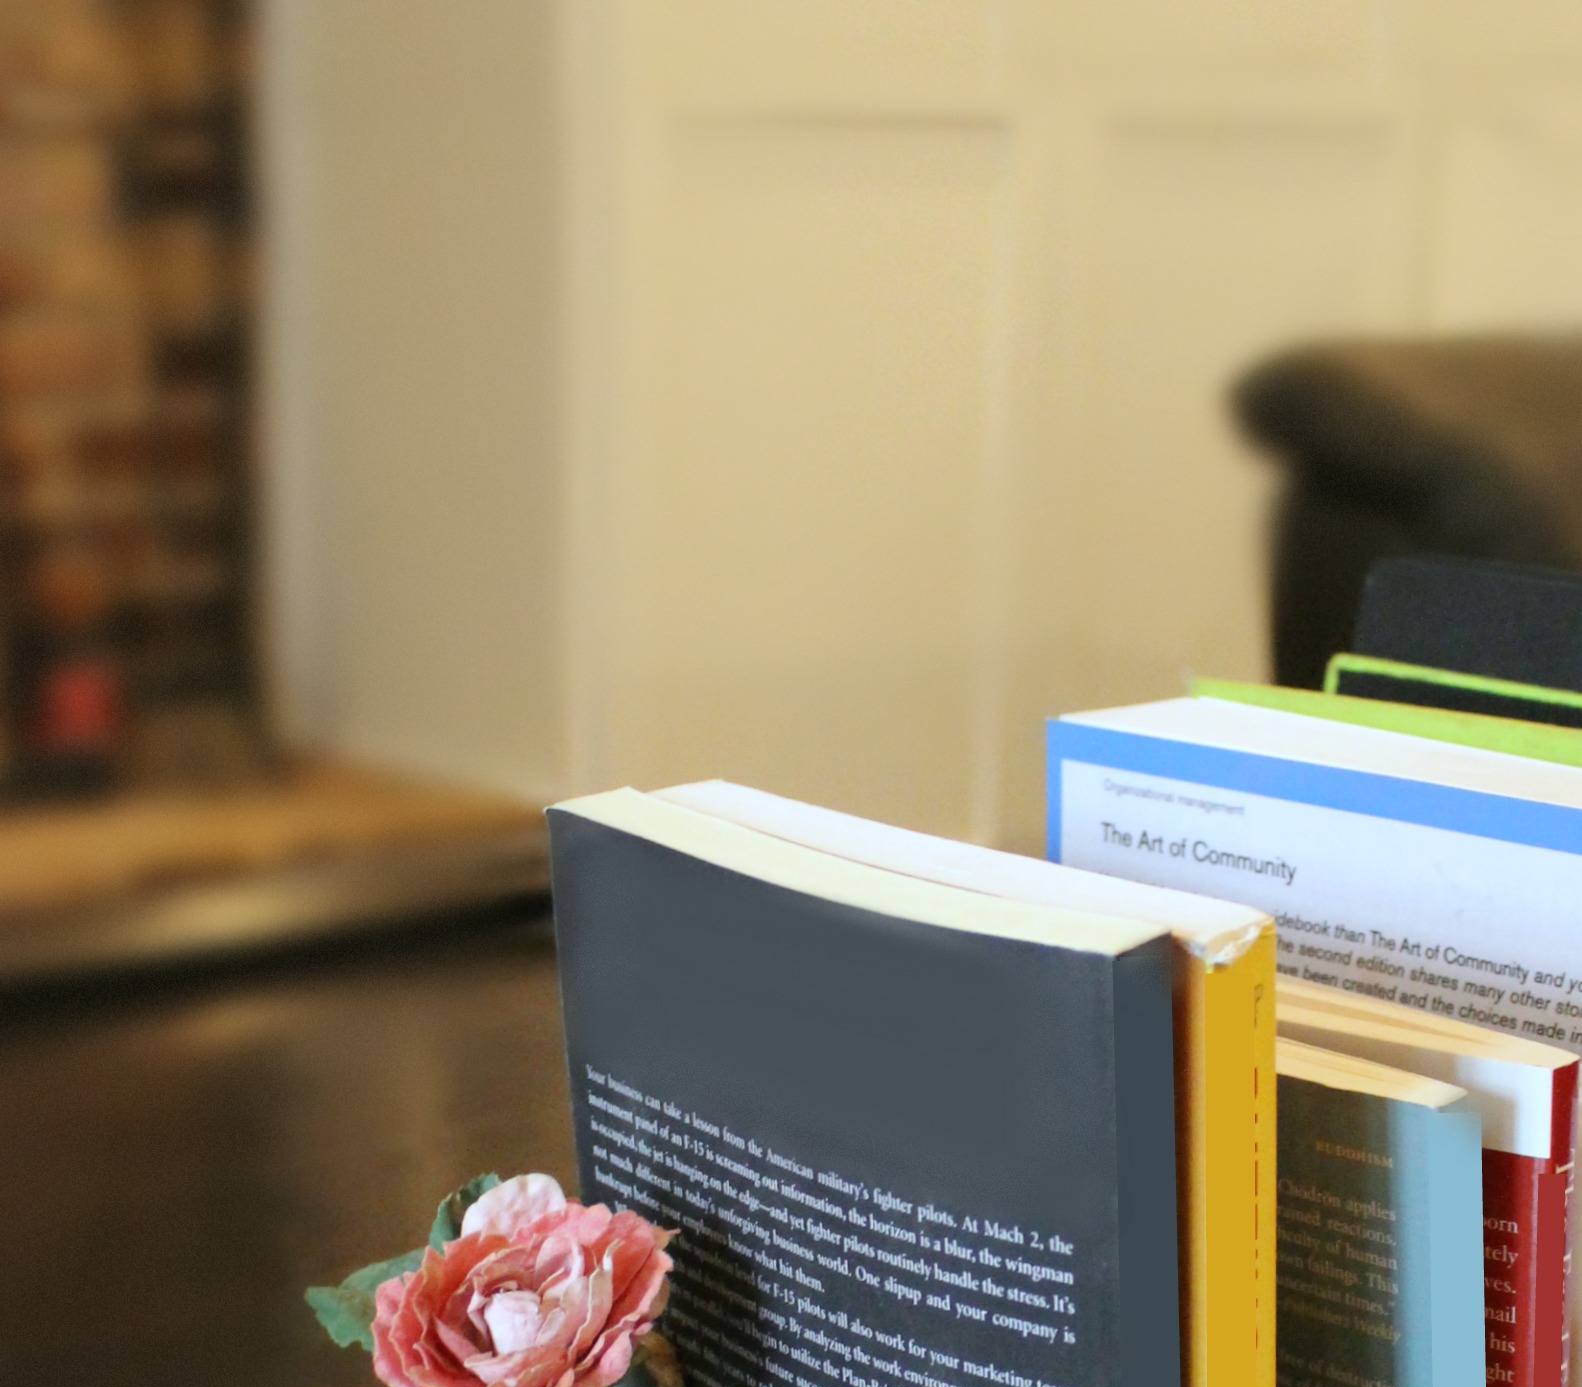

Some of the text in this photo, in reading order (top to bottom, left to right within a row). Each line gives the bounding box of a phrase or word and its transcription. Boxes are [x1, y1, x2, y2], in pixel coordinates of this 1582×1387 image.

[1101, 822, 1297, 886] The Art of Community
[1298, 944, 1352, 966] second
[1356, 956, 1404, 978] edition
[1410, 967, 1458, 990] shares
[1463, 981, 1506, 1004] many
[1510, 990, 1551, 1011] other
[1334, 924, 1366, 944] than
[1370, 930, 1396, 951] The
[1400, 938, 1421, 957] Art
[1424, 945, 1440, 960] of
[1444, 947, 1529, 985] Community
[1534, 972, 1566, 988] and
[1302, 965, 1338, 988] been
[1342, 978, 1398, 1002] created
[1400, 992, 1428, 1008] and
[1432, 996, 1454, 1014] the
[1458, 1004, 1518, 1031] choices
[1522, 1020, 1566, 1041] made
[766, 1148, 1074, 1256] American military's fighter pilots. At Mach 2, the
[843, 1235, 1076, 1315] pilots routinely handle the stress. It's
[848, 1207, 1074, 1285] the horizon is a blur, the wingman
[797, 1297, 826, 1320] pilots
[828, 1311, 848, 1329] will
[850, 1318, 873, 1339] also
[875, 1331, 906, 1351] work
[908, 1338, 927, 1359] for
[929, 1350, 960, 1369] your
[855, 1265, 1076, 1344] One slipup and your company is
[803, 1328, 852, 1361] analyzing
[852, 1345, 871, 1365] the
[872, 1357, 902, 1377] work
[822, 1359, 840, 1379] the
[1490, 1333, 1516, 1354] his
